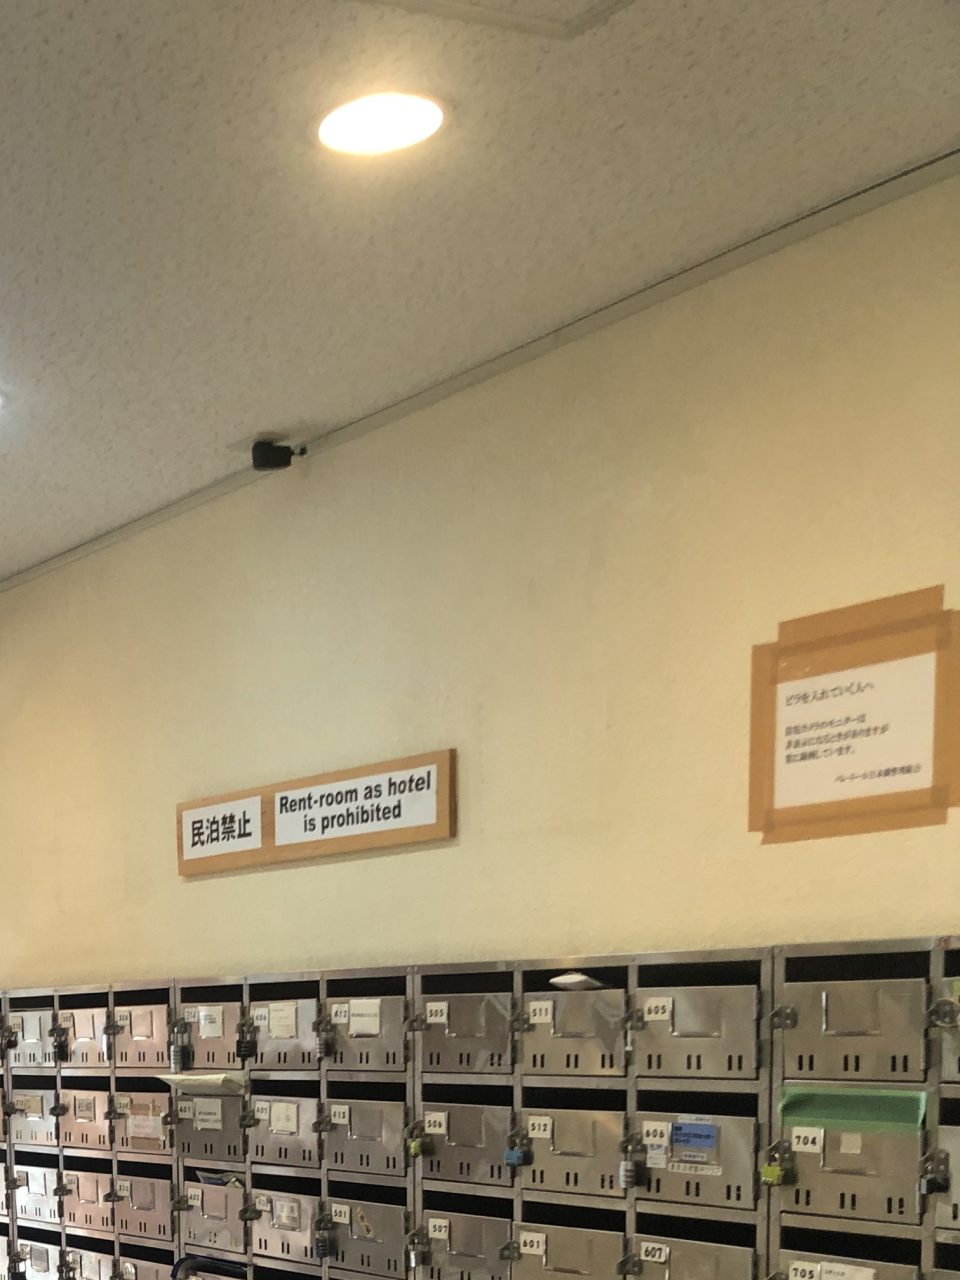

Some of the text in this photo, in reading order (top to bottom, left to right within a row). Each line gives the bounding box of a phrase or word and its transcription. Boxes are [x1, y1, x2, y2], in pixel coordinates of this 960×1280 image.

[279, 770, 432, 815] Rent-room as hotel
[303, 800, 402, 835] is prohibited
[191, 810, 253, 848] 民泊禁止
[428, 1008, 444, 1018] 505
[532, 1007, 549, 1017] 511
[647, 1005, 666, 1014] 605
[427, 1120, 443, 1129] 506
[531, 1122, 548, 1131] 512
[645, 1129, 665, 1138] 606
[795, 1135, 817, 1147] 704
[334, 1209, 347, 1218] 501
[432, 1225, 448, 1234] 507
[523, 1239, 540, 1249] 601
[644, 1246, 662, 1259] 607
[792, 1267, 814, 1280] 705
